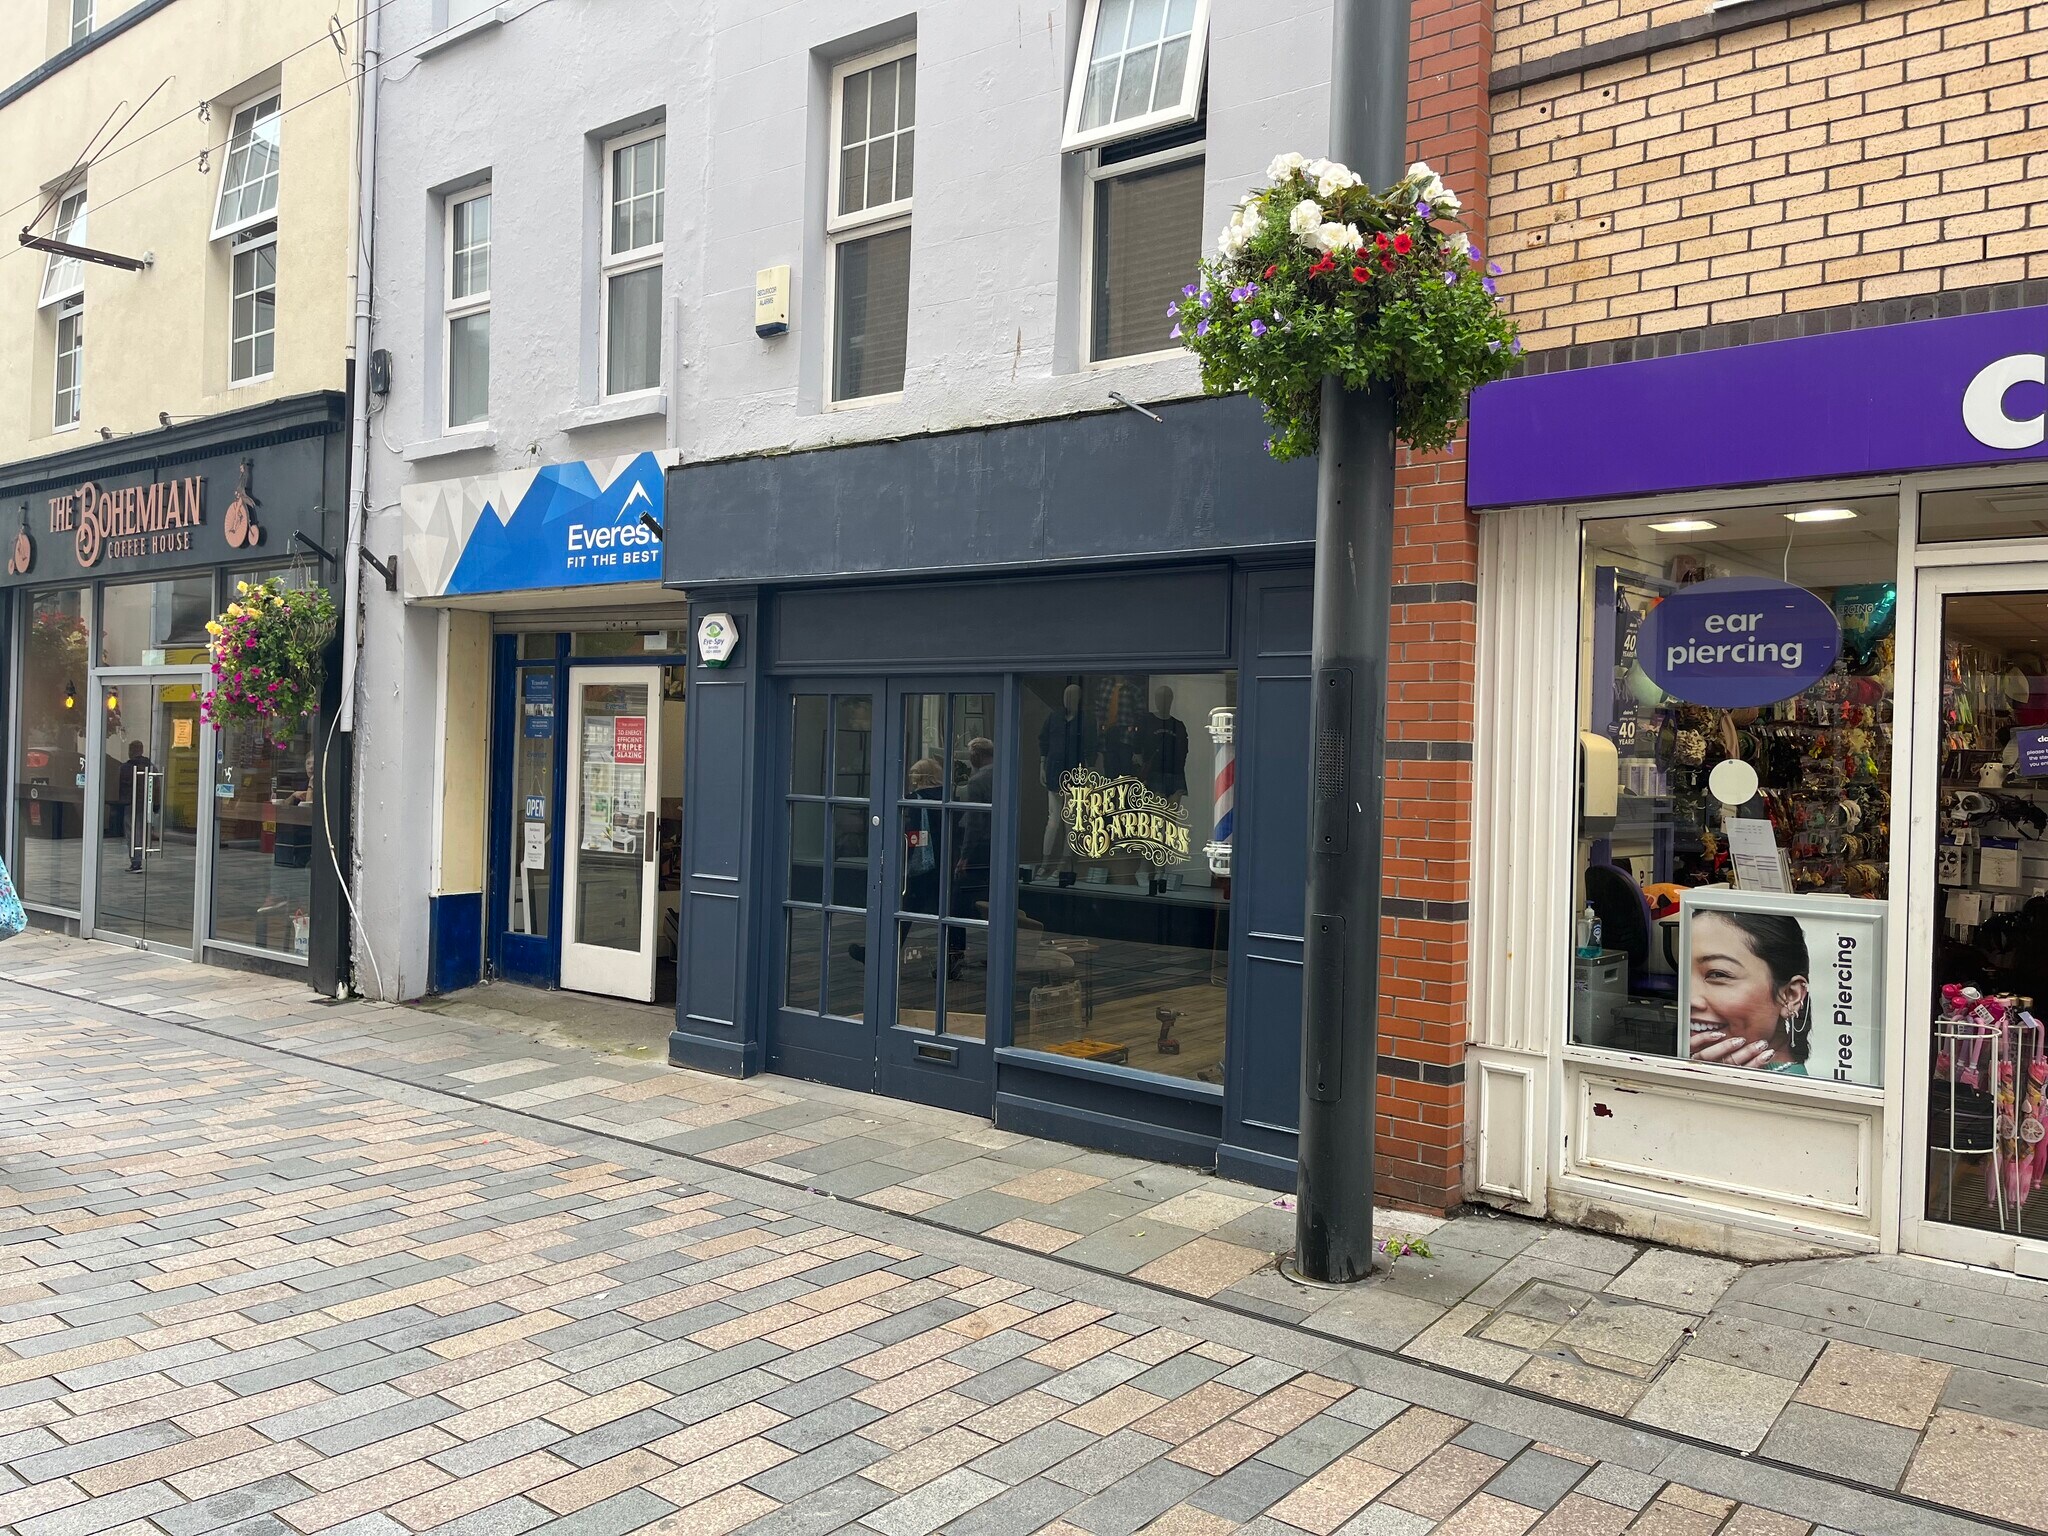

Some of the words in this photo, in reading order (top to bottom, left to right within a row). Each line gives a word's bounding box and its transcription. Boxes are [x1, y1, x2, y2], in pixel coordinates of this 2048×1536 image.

[48, 495, 74, 533] THE
[108, 537, 146, 559] COFFEE
[152, 531, 191, 555] HOUSE
[568, 517, 660, 551] Everest
[567, 556, 587, 569] FIT
[592, 554, 617, 567] THE
[623, 550, 659, 564] BEST
[1705, 612, 1764, 634] ear
[1623, 634, 1637, 651] 40
[1666, 635, 1803, 672] piercing
[1618, 722, 1636, 738] 40
[616, 743, 643, 751] TRIPLE
[616, 751, 642, 759] GLAZING
[526, 798, 545, 817] OPEN
[1068, 784, 1129, 832] TREY
[1083, 812, 1191, 858] BARBERS
[1833, 1033, 1853, 1082] Free
